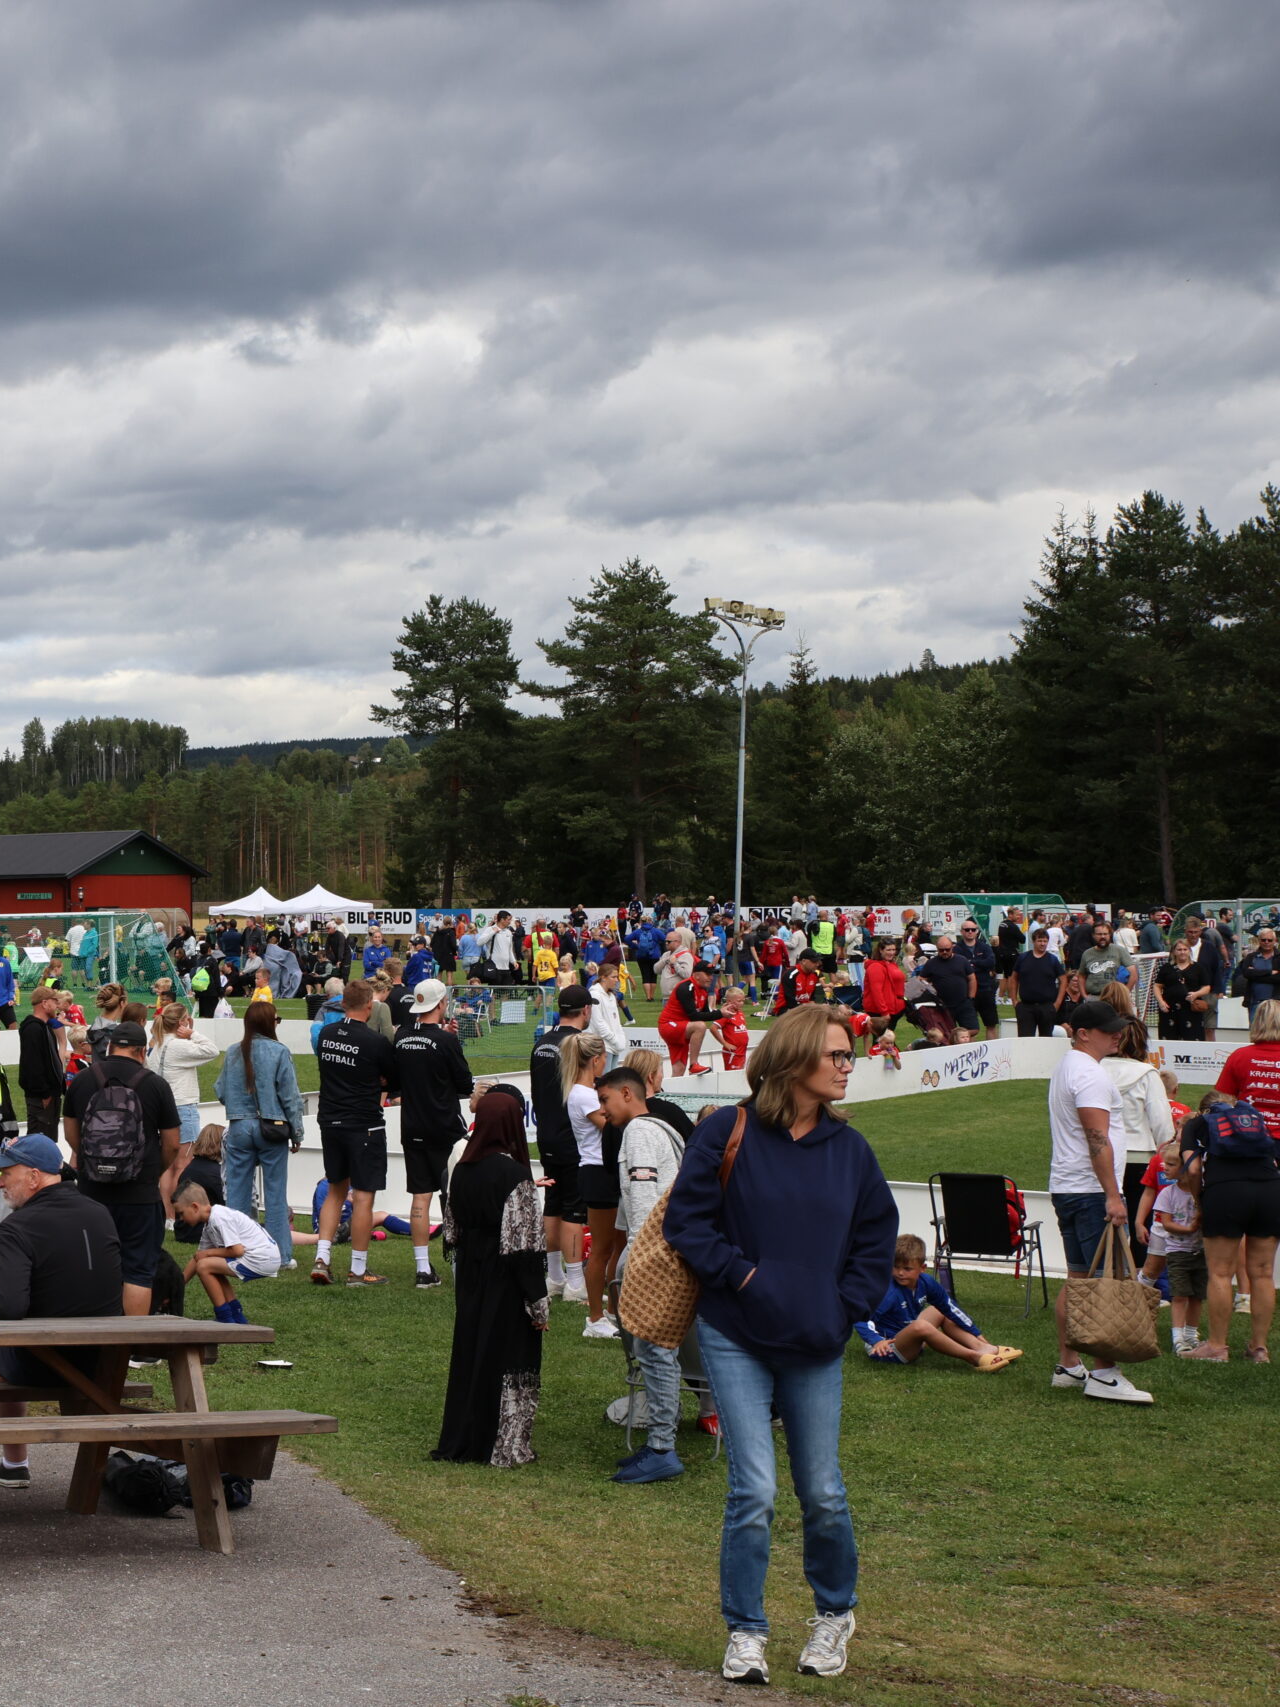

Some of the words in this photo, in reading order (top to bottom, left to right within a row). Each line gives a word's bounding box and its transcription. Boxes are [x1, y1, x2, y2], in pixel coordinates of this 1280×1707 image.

[347, 911, 413, 924] BILERUD
[945, 911, 952, 922] 5
[322, 1039, 360, 1055] EIDSKOG
[321, 1052, 357, 1067] FOTBALL
[958, 1061, 989, 1082] CUP
